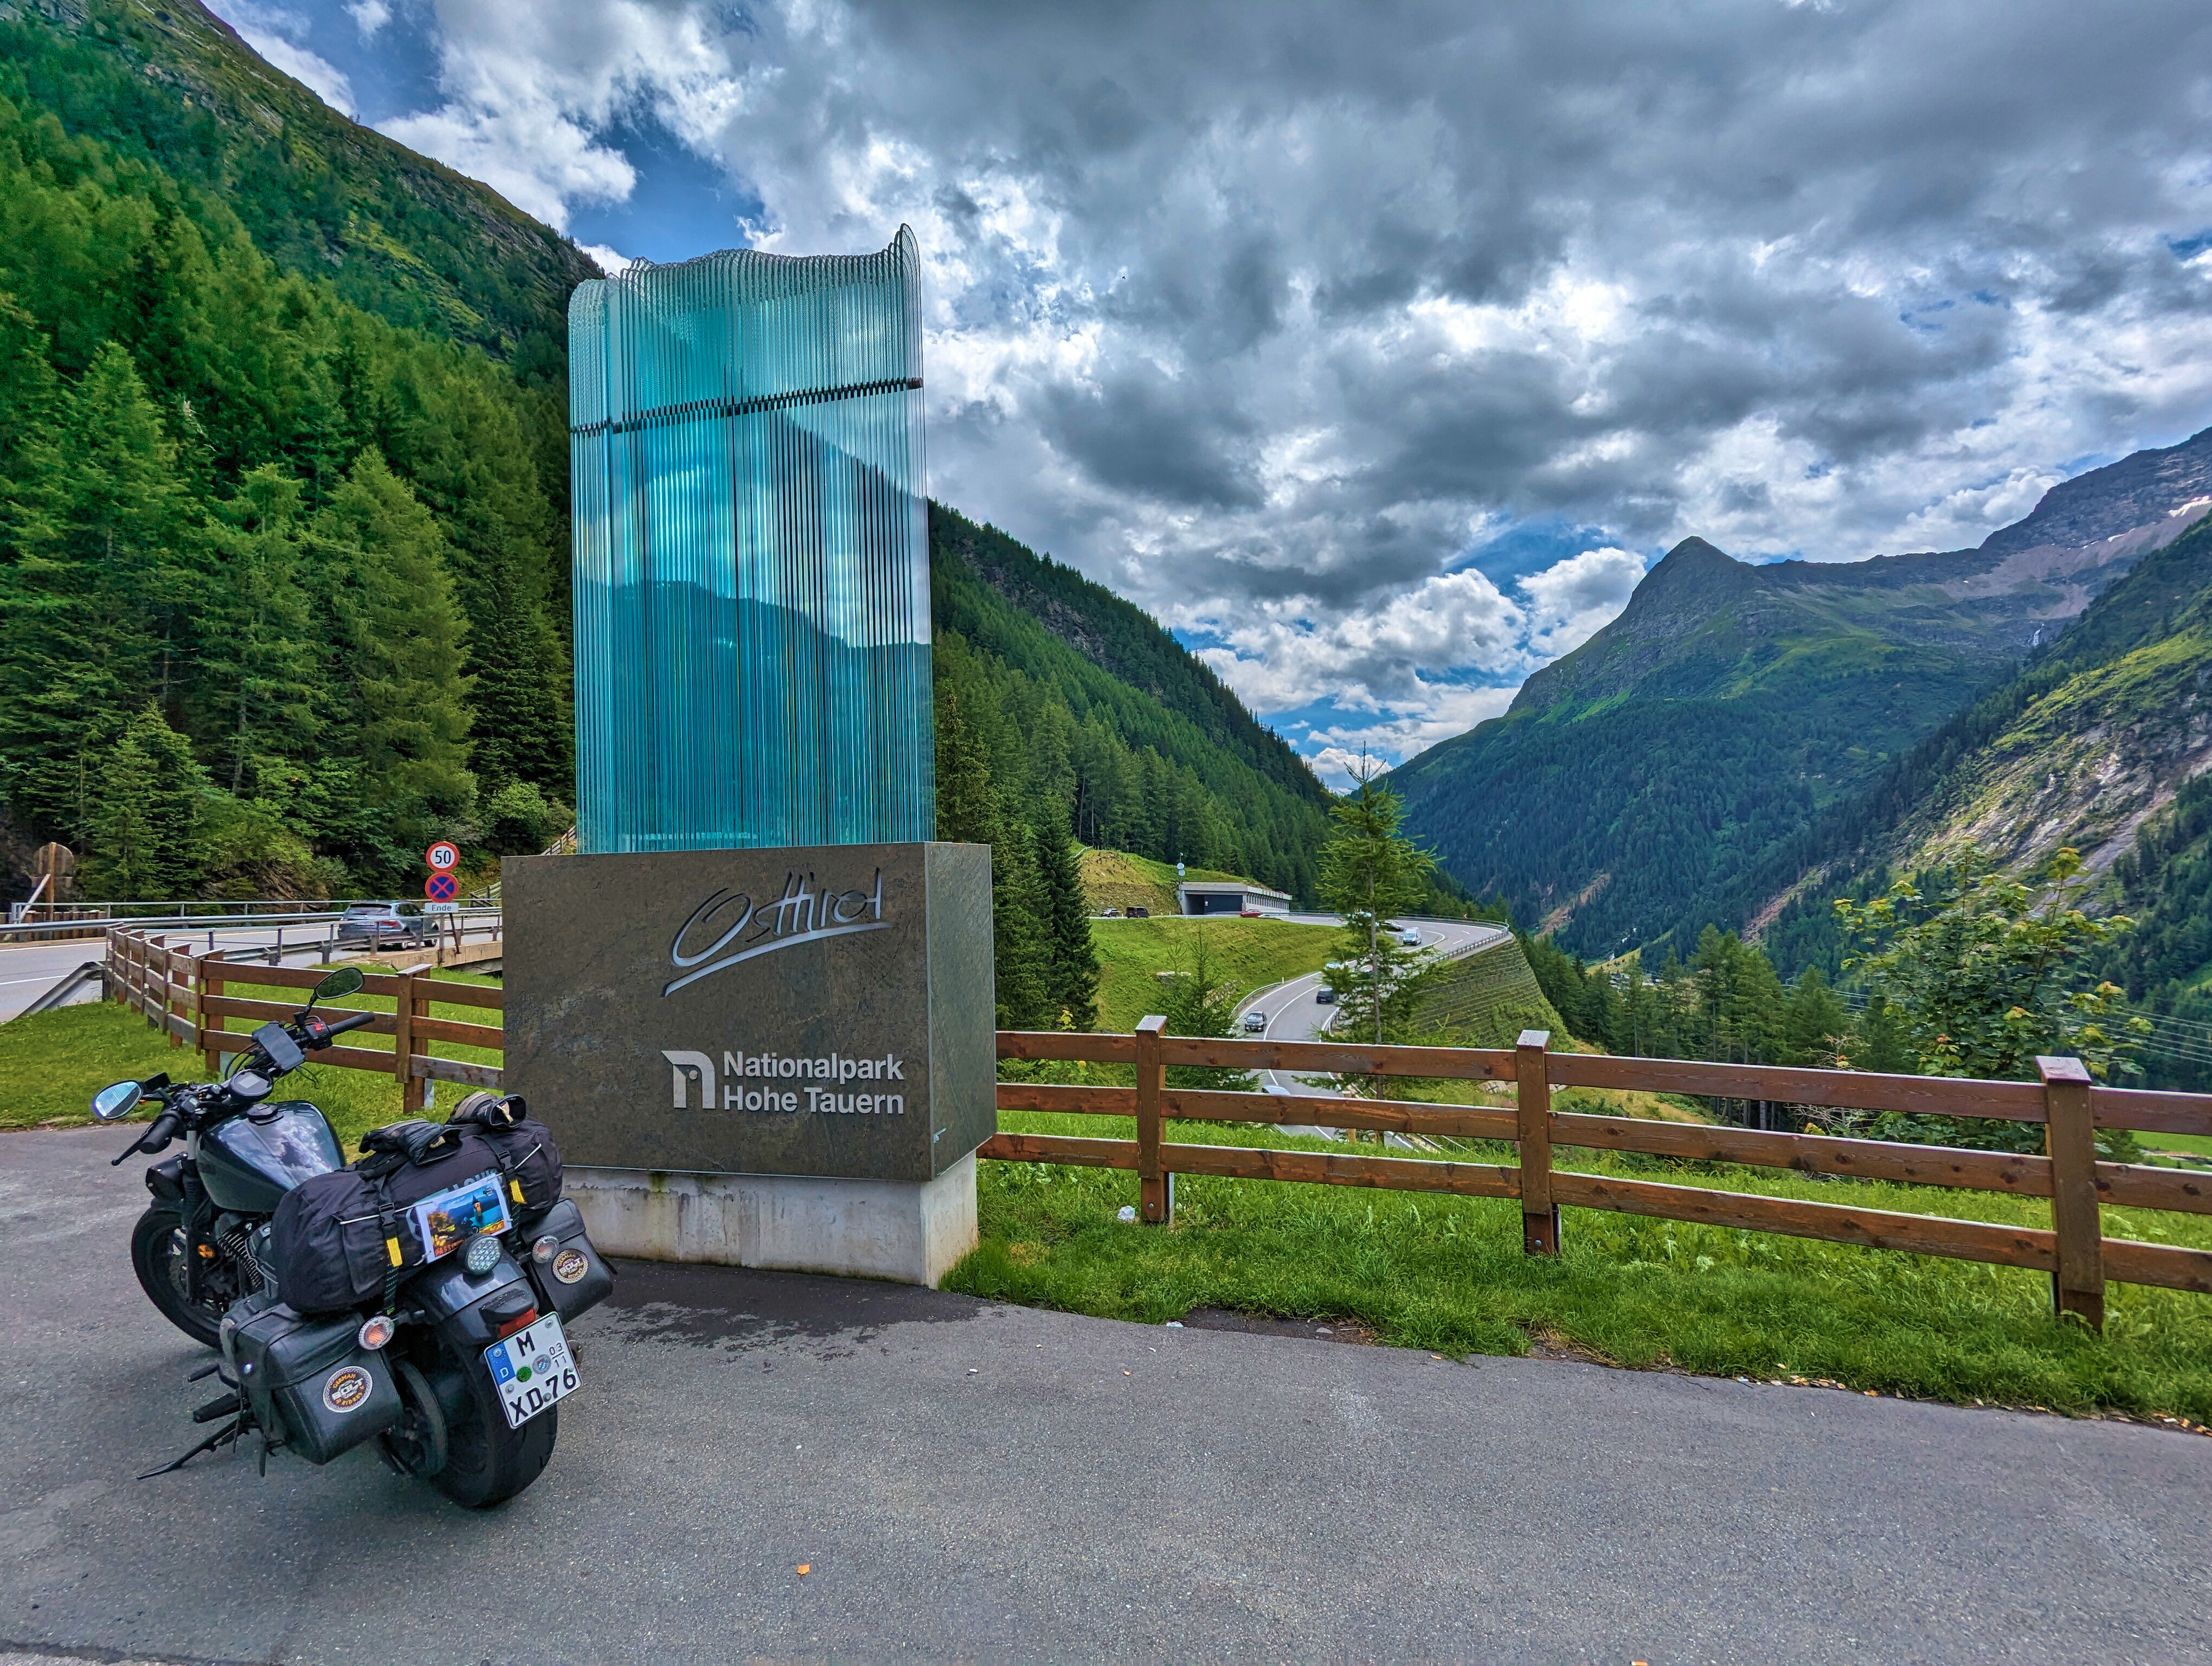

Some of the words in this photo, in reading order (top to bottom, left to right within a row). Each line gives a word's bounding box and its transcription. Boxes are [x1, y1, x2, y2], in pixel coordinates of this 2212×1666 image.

[435, 850, 451, 864] 50
[672, 867, 882, 967] Osttirol
[724, 1051, 904, 1085] Nationalpark
[724, 1085, 798, 1112] Hohe
[804, 1087, 904, 1114] Tauern
[516, 1330, 535, 1357] M
[549, 1342, 563, 1355] 03
[555, 1355, 567, 1367] 11
[500, 1367, 509, 1378] D
[332, 1378, 363, 1400] BOLT
